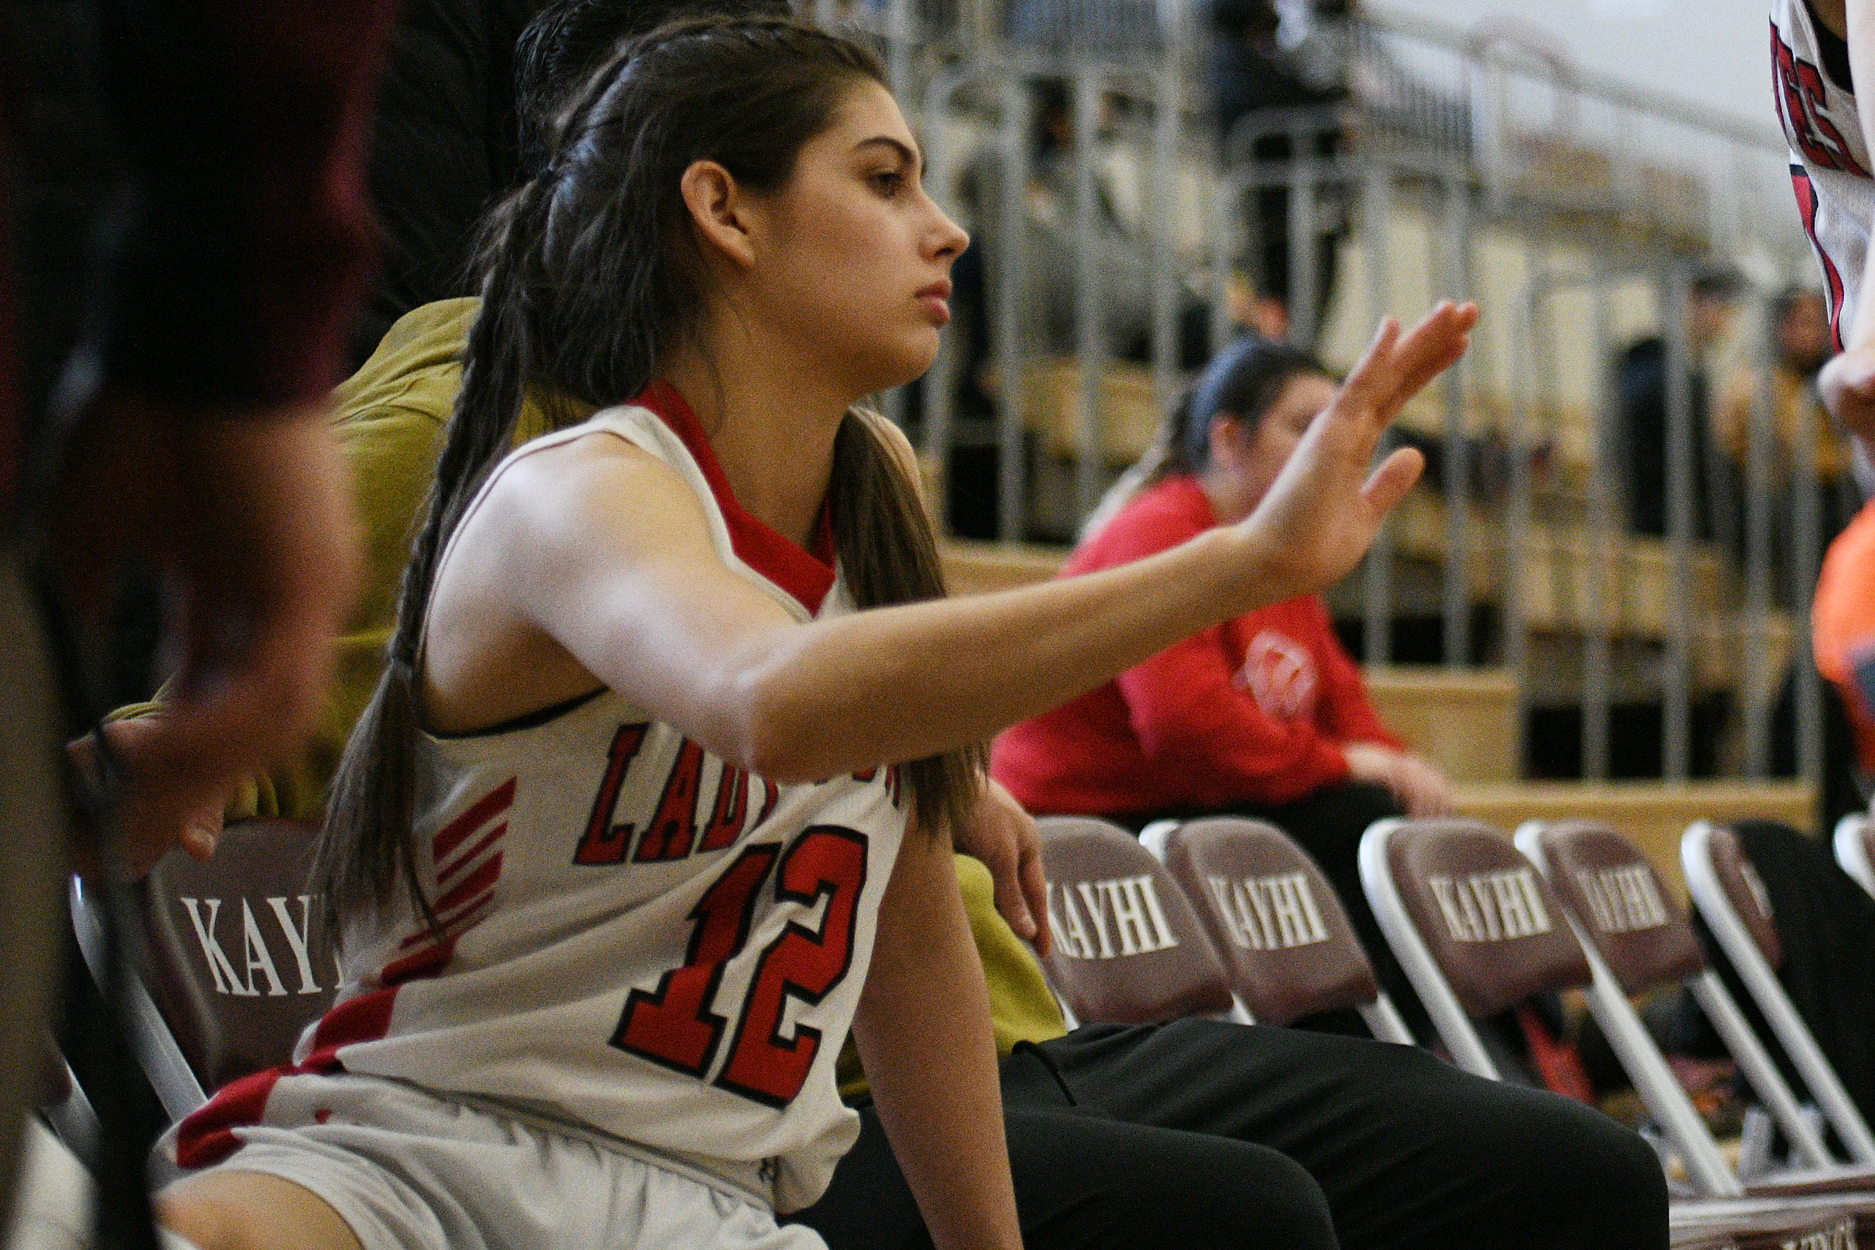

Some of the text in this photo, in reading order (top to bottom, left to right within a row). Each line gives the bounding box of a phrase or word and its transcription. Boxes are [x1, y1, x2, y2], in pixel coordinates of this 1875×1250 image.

[1207, 872, 1330, 950] KAYHI
[1429, 868, 1550, 942] KAYHI
[608, 823, 869, 1110] 12
